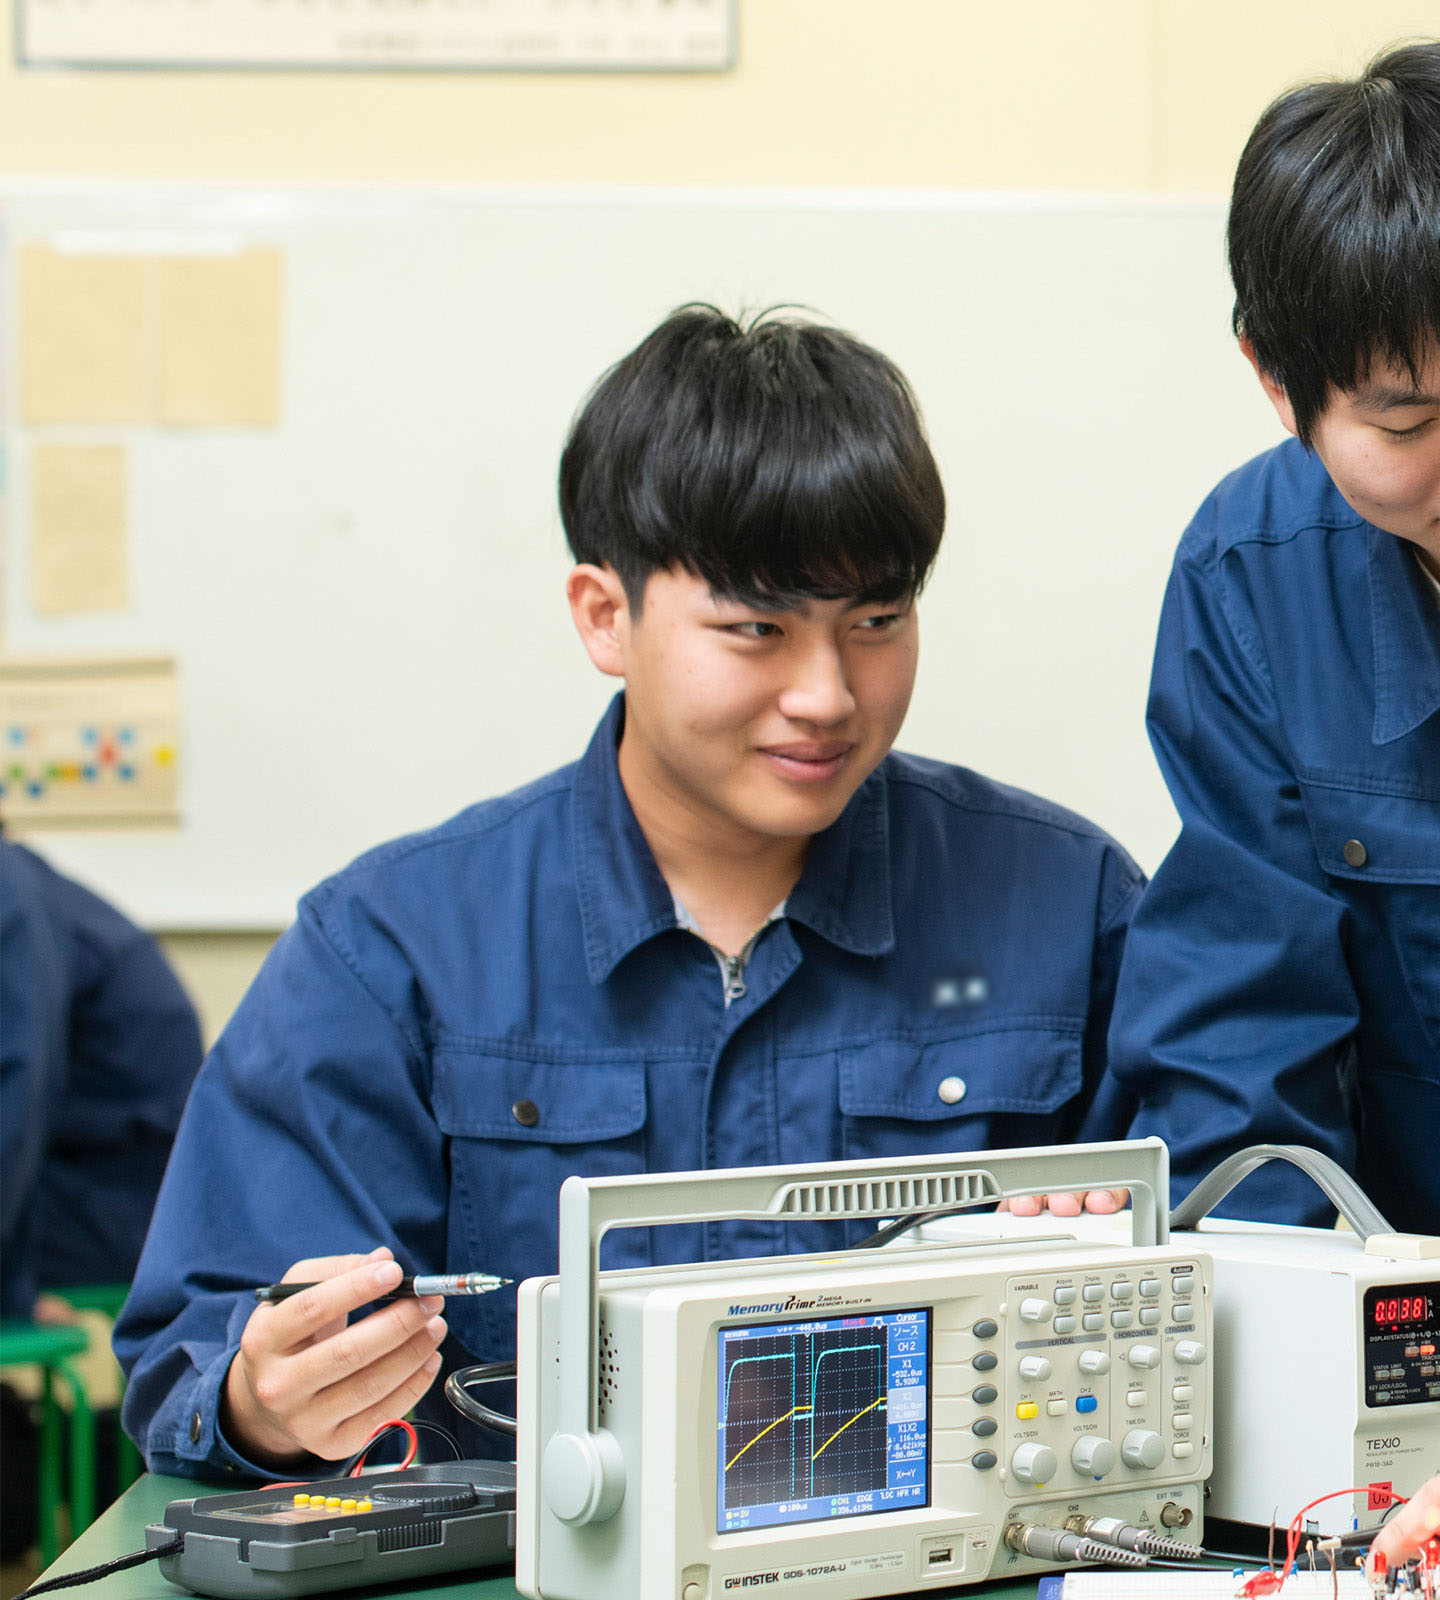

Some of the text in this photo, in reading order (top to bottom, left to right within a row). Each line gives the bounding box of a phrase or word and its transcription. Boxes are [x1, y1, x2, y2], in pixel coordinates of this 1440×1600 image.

[896, 1313, 917, 1322] Cursor
[893, 1325, 919, 1337] ソース
[1118, 1329, 1153, 1338] HORIZONTAL
[1047, 1338, 1075, 1347] VERTICAL
[902, 1359, 912, 1369] X1
[898, 1422, 917, 1433] X1X2
[1073, 1424, 1098, 1432] VOLTS/DIV
[1366, 1437, 1400, 1450] TEXIO
[856, 1494, 873, 1503] EDGE
[742, 1572, 779, 1587] INSTEK
[783, 1564, 846, 1579] GDS-1072A-U
